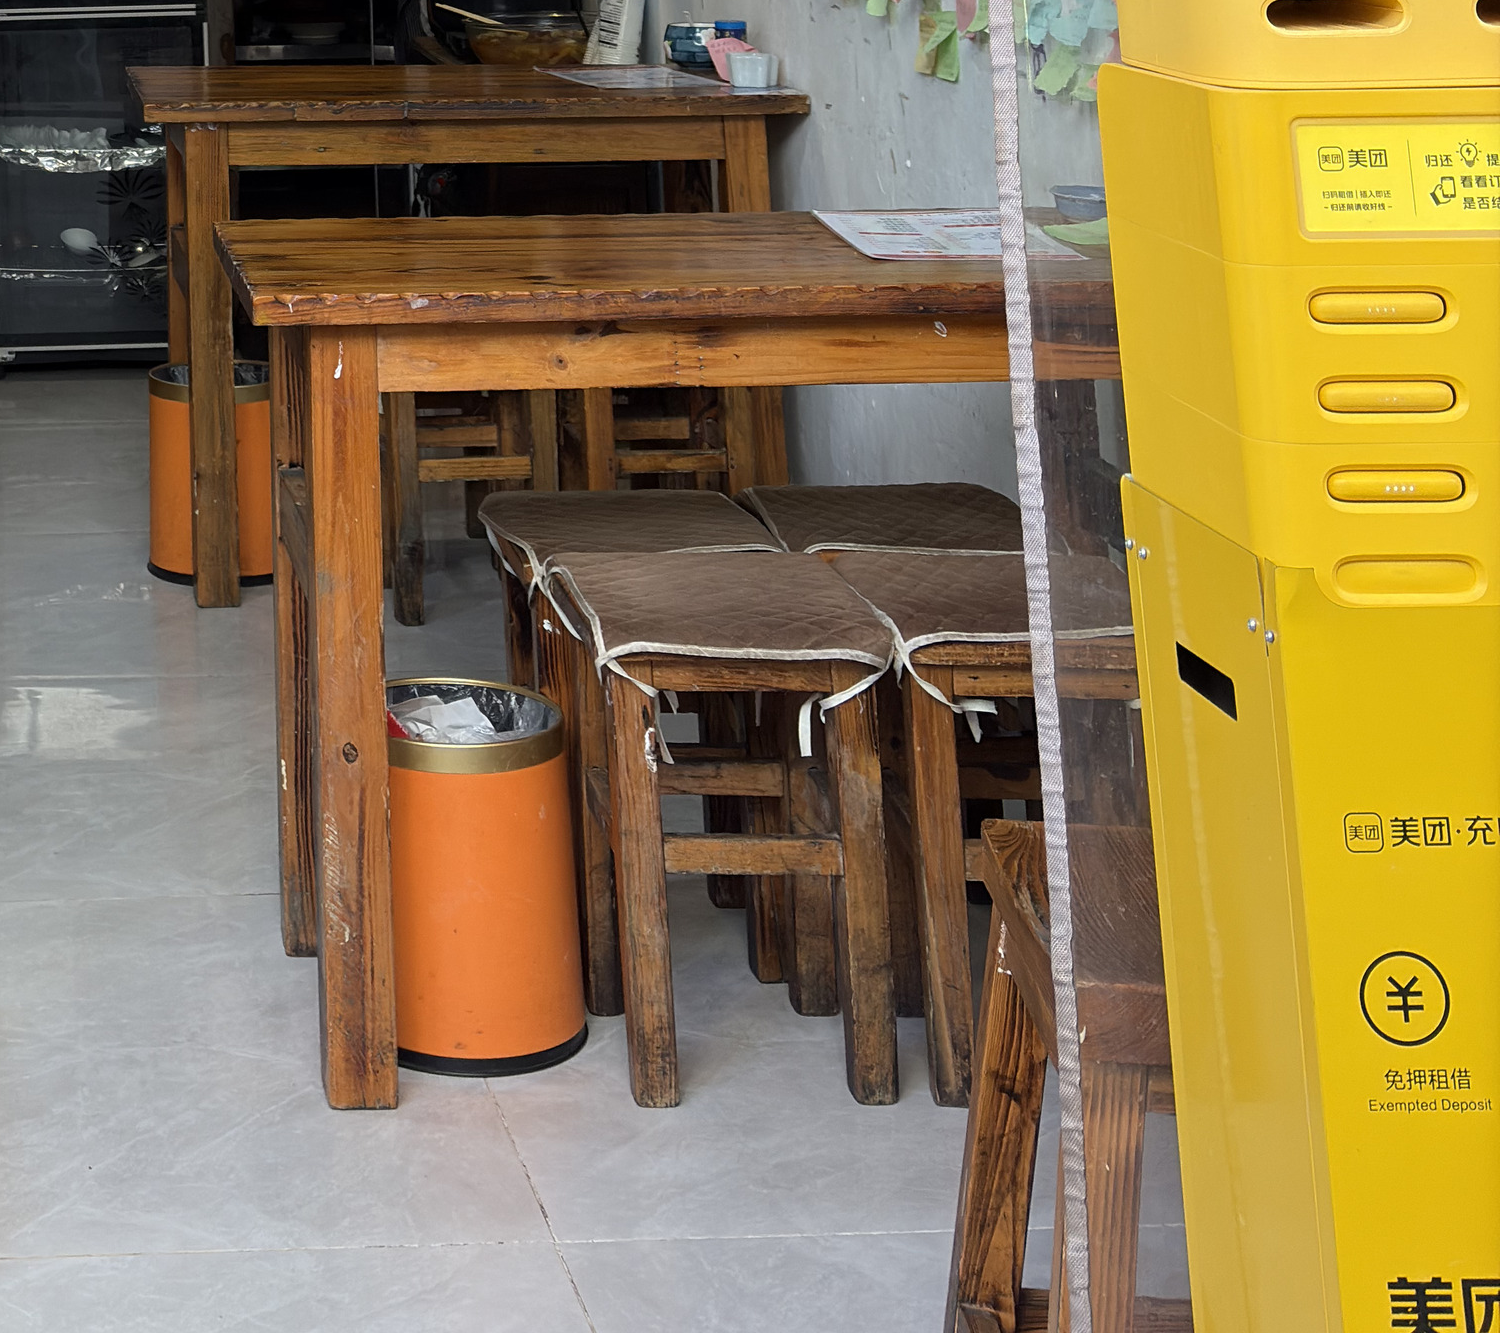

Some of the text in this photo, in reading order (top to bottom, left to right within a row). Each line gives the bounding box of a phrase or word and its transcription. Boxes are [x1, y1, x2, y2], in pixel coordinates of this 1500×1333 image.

[1321, 148, 1389, 168] 美团 美团
[1425, 154, 1453, 167] 归还
[1349, 815, 1500, 848] 美团 美团·充
[1384, 1068, 1471, 1091] 免押租借
[1368, 1098, 1493, 1114] Exempted Deposit
